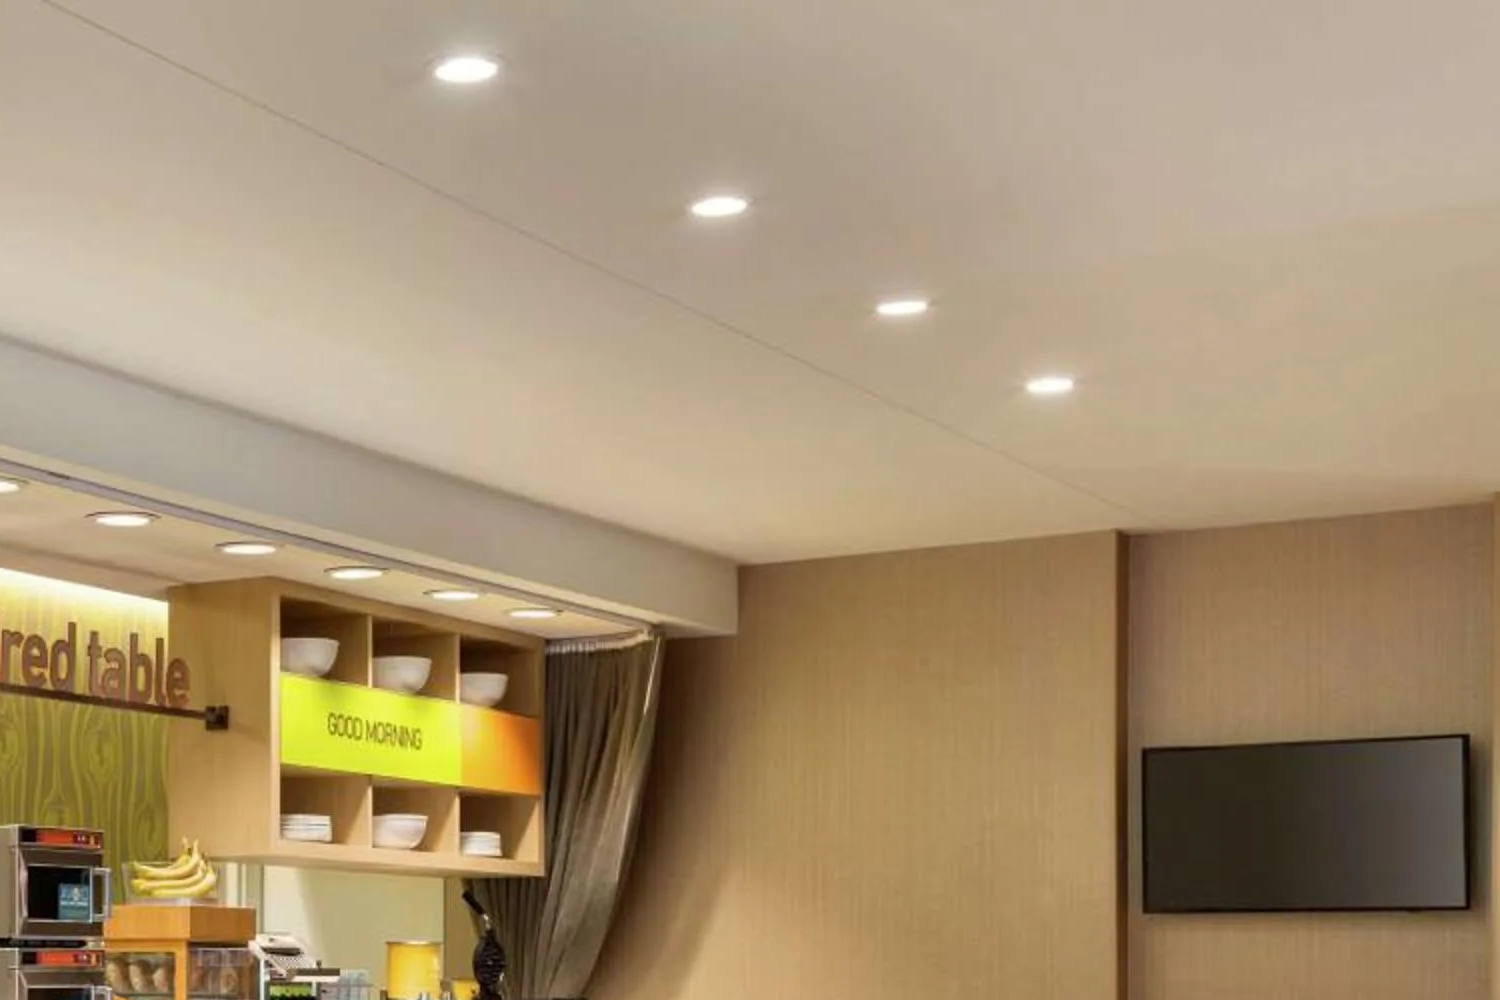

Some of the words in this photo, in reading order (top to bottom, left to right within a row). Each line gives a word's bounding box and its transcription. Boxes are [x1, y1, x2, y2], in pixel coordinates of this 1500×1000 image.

[86, 630, 191, 707] table
[327, 712, 363, 741] GOOD
[365, 719, 423, 751] MORNING
